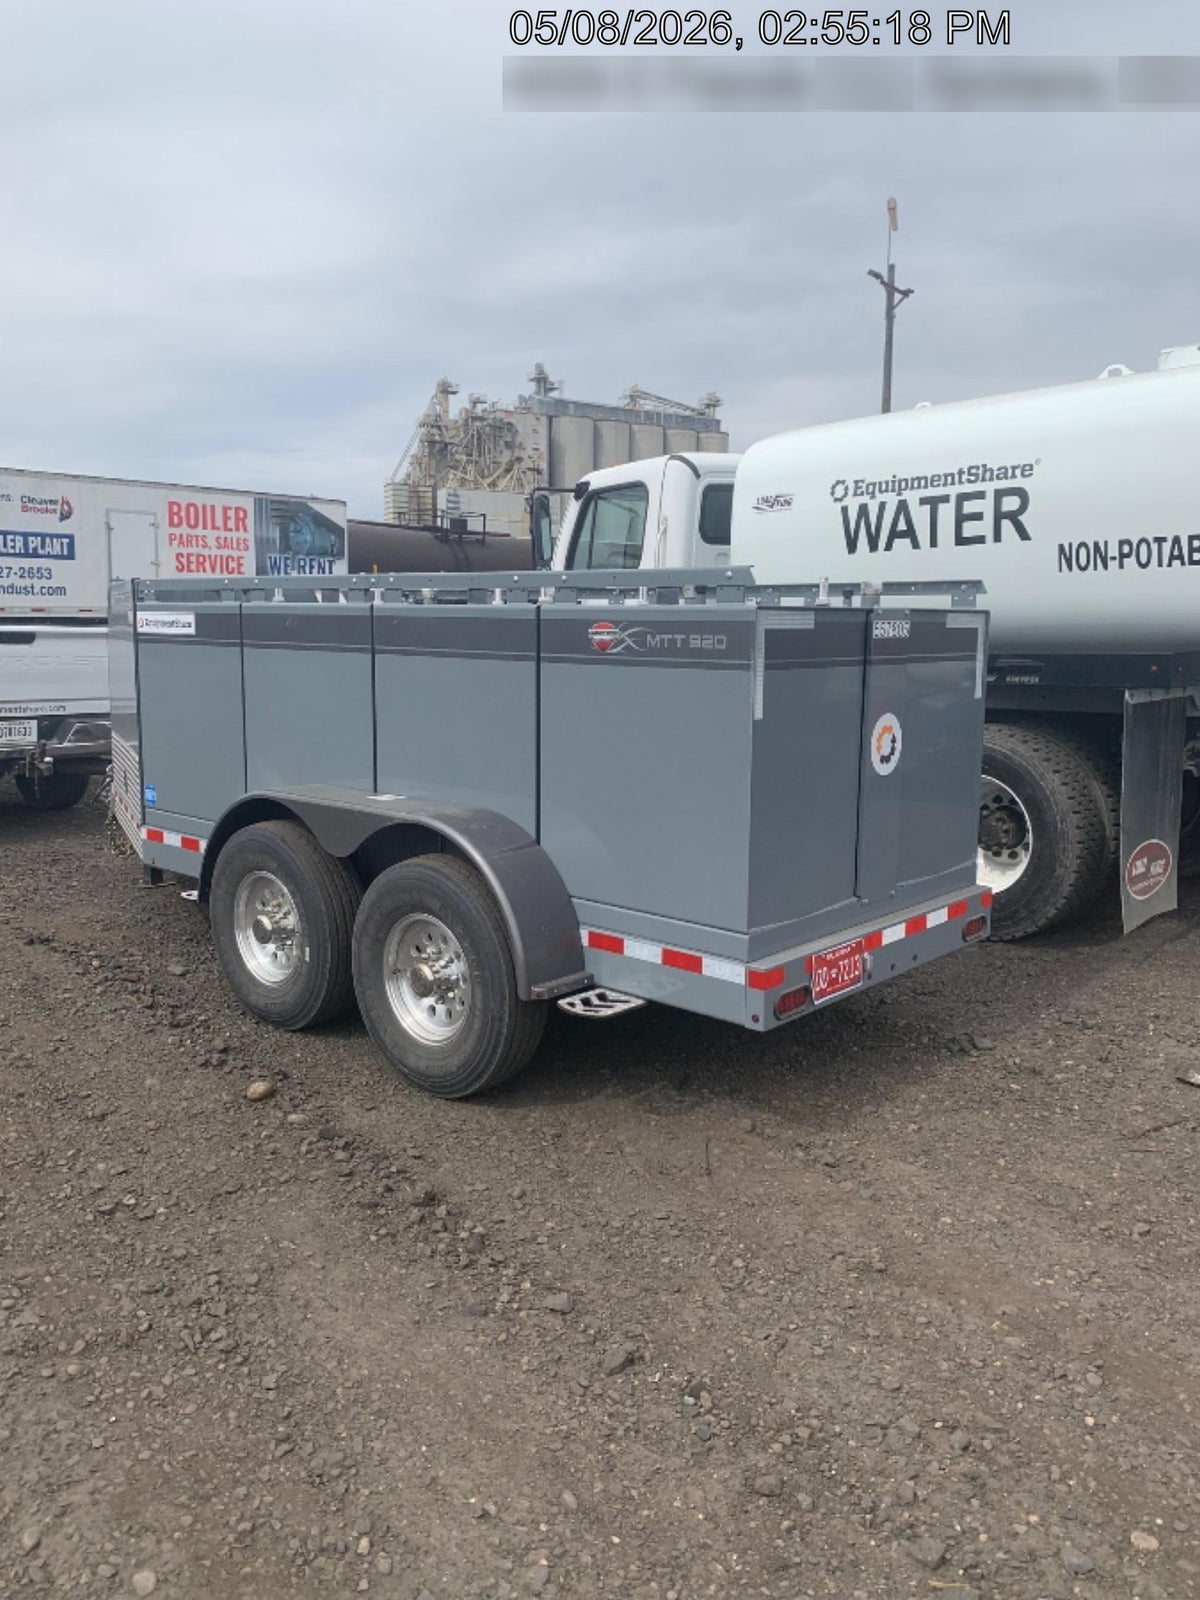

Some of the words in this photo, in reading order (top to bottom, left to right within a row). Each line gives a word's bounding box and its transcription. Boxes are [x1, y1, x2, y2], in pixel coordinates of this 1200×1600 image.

[852, 462, 1035, 500] EquipmentShare
[168, 500, 249, 533] BOILER
[840, 486, 1032, 556] WATER
[28, 536, 70, 556] PLANT
[168, 532, 212, 551] PARTS,
[215, 536, 250, 552] SALES
[175, 552, 245, 575] SERVICE
[268, 555, 291, 576] WE
[646, 634, 685, 649] MTT
[689, 634, 727, 650] 920
